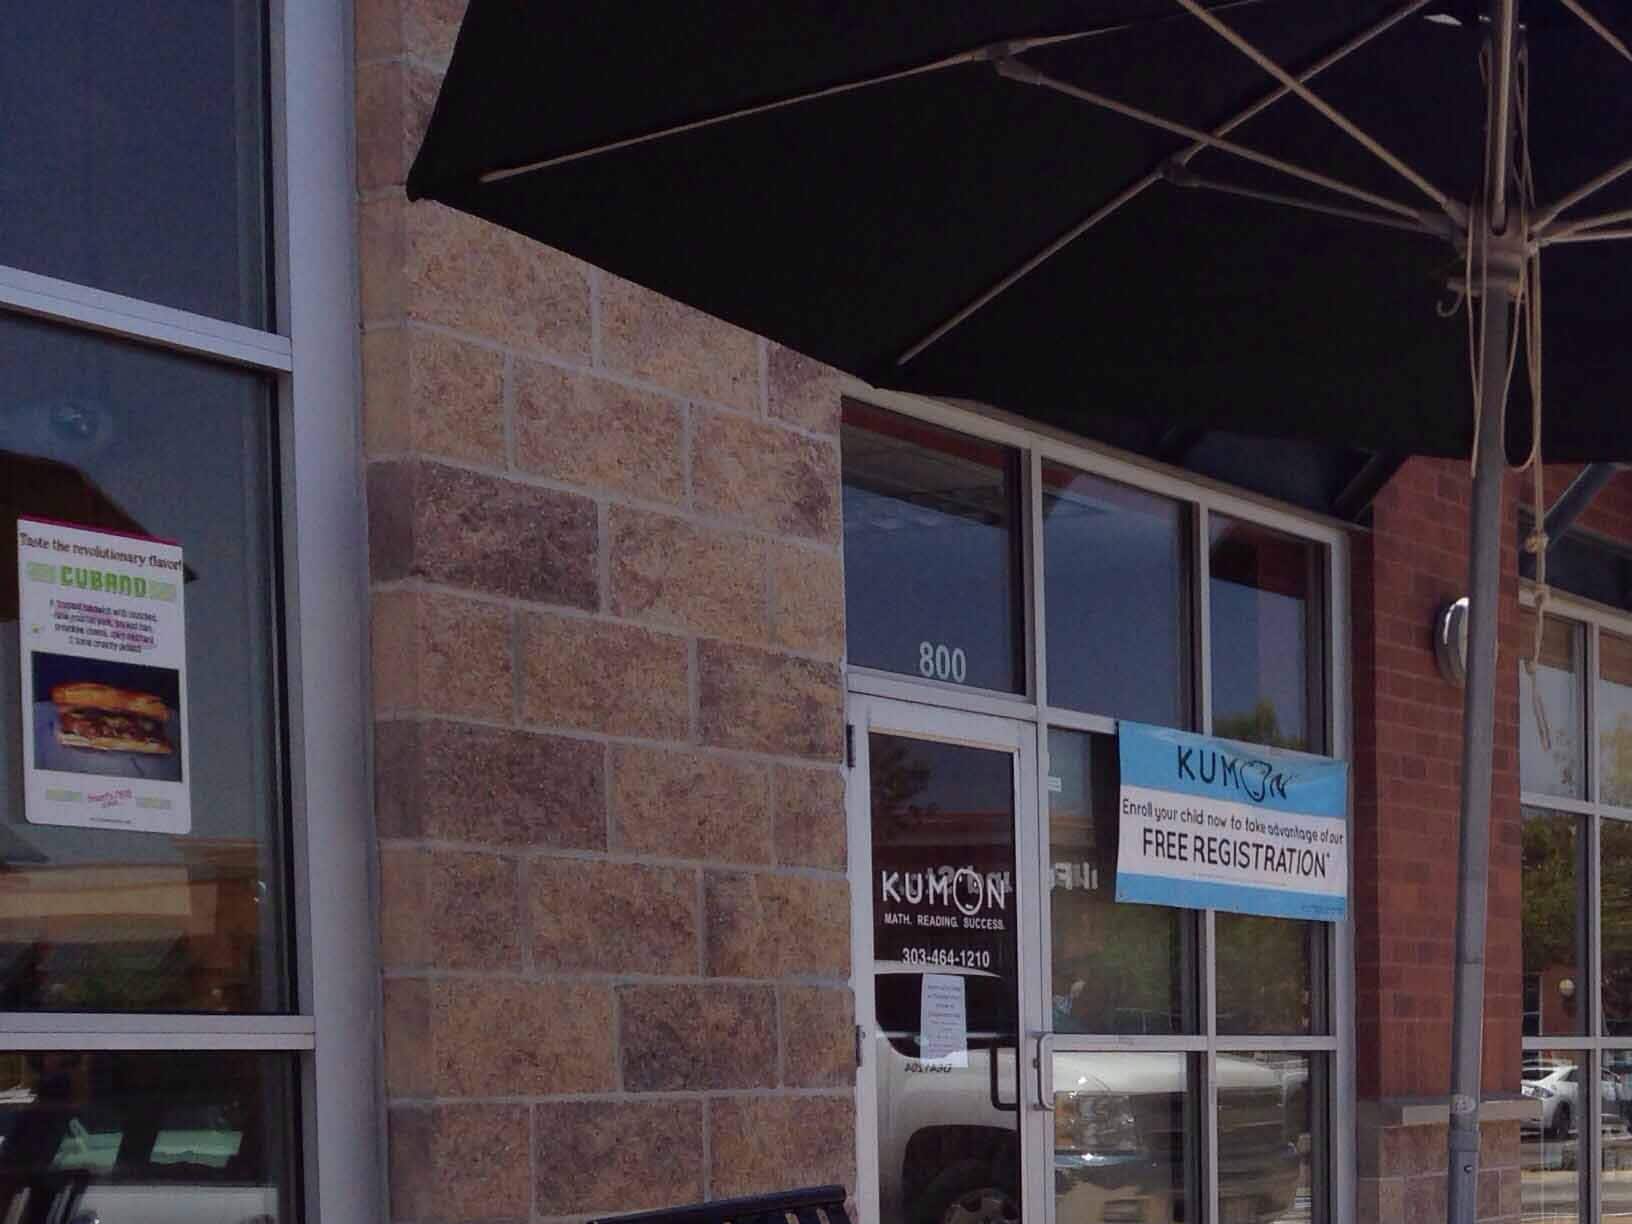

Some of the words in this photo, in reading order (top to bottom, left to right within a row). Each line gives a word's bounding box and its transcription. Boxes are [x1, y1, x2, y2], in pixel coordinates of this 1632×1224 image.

[18, 531, 49, 549] Taste
[52, 537, 71, 552] the
[72, 544, 147, 568] revolutionary
[919, 640, 967, 683] 800
[1177, 745, 1292, 802] KUMON
[1122, 798, 1153, 818] Enroll
[1153, 806, 1178, 823] your
[1180, 808, 1204, 825] child
[1207, 814, 1228, 829] now
[1230, 817, 1242, 830] to
[1245, 819, 1266, 834] take
[1267, 824, 1318, 843] advantage
[1320, 830, 1330, 845] of
[1142, 827, 1189, 862] FREE
[881, 868, 1006, 916] KUMON
[884, 912, 912, 925] MATH.
[902, 947, 990, 968] 303-464-1210
